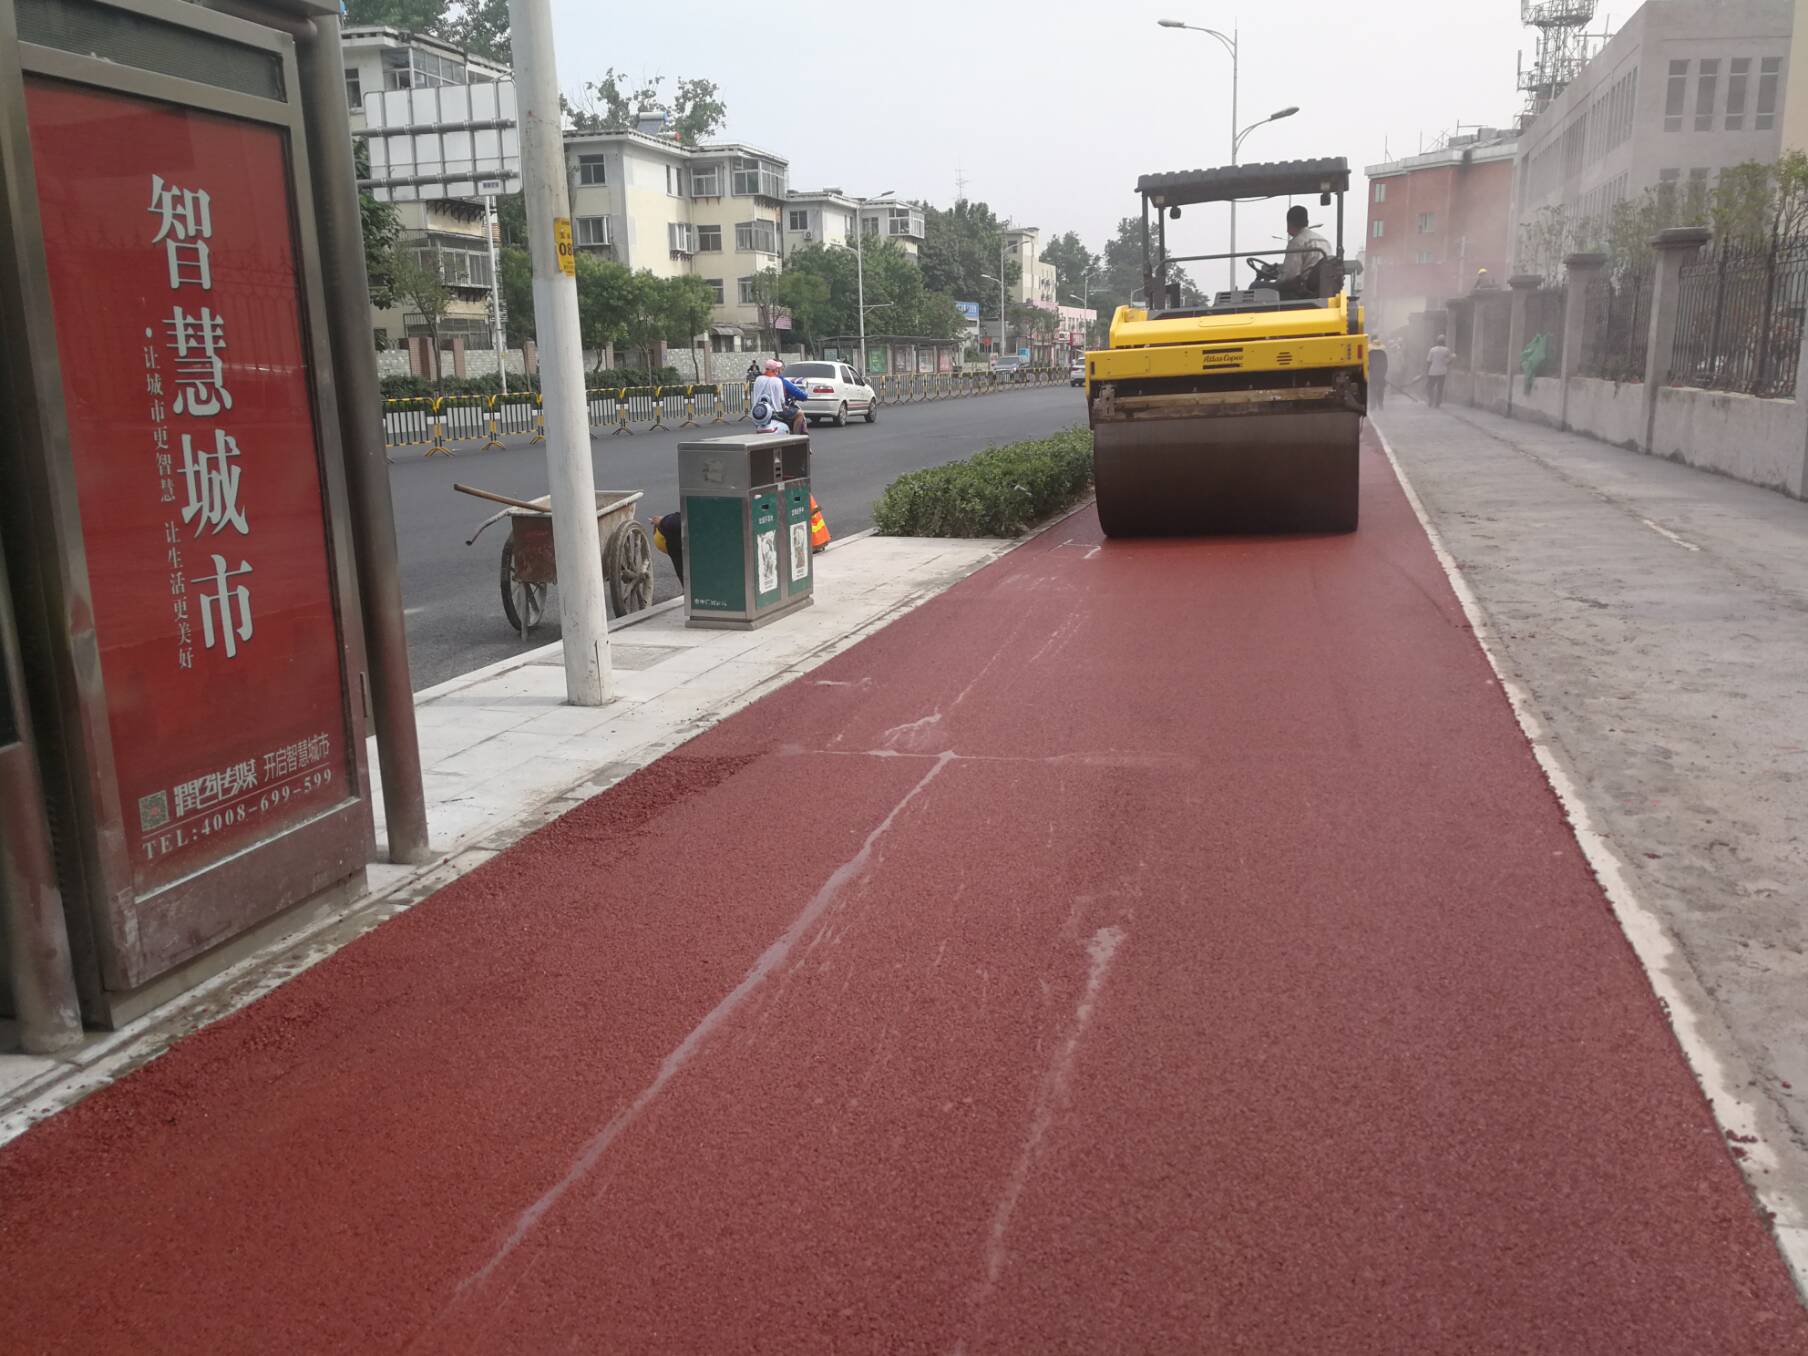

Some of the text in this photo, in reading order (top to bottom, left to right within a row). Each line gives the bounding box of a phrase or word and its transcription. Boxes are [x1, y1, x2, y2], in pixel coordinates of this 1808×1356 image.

[143, 345, 194, 670] 让城市更智慧 让生活更美好
[148, 174, 253, 658] 智慧城市
[263, 731, 330, 782] 开启智慧城市
